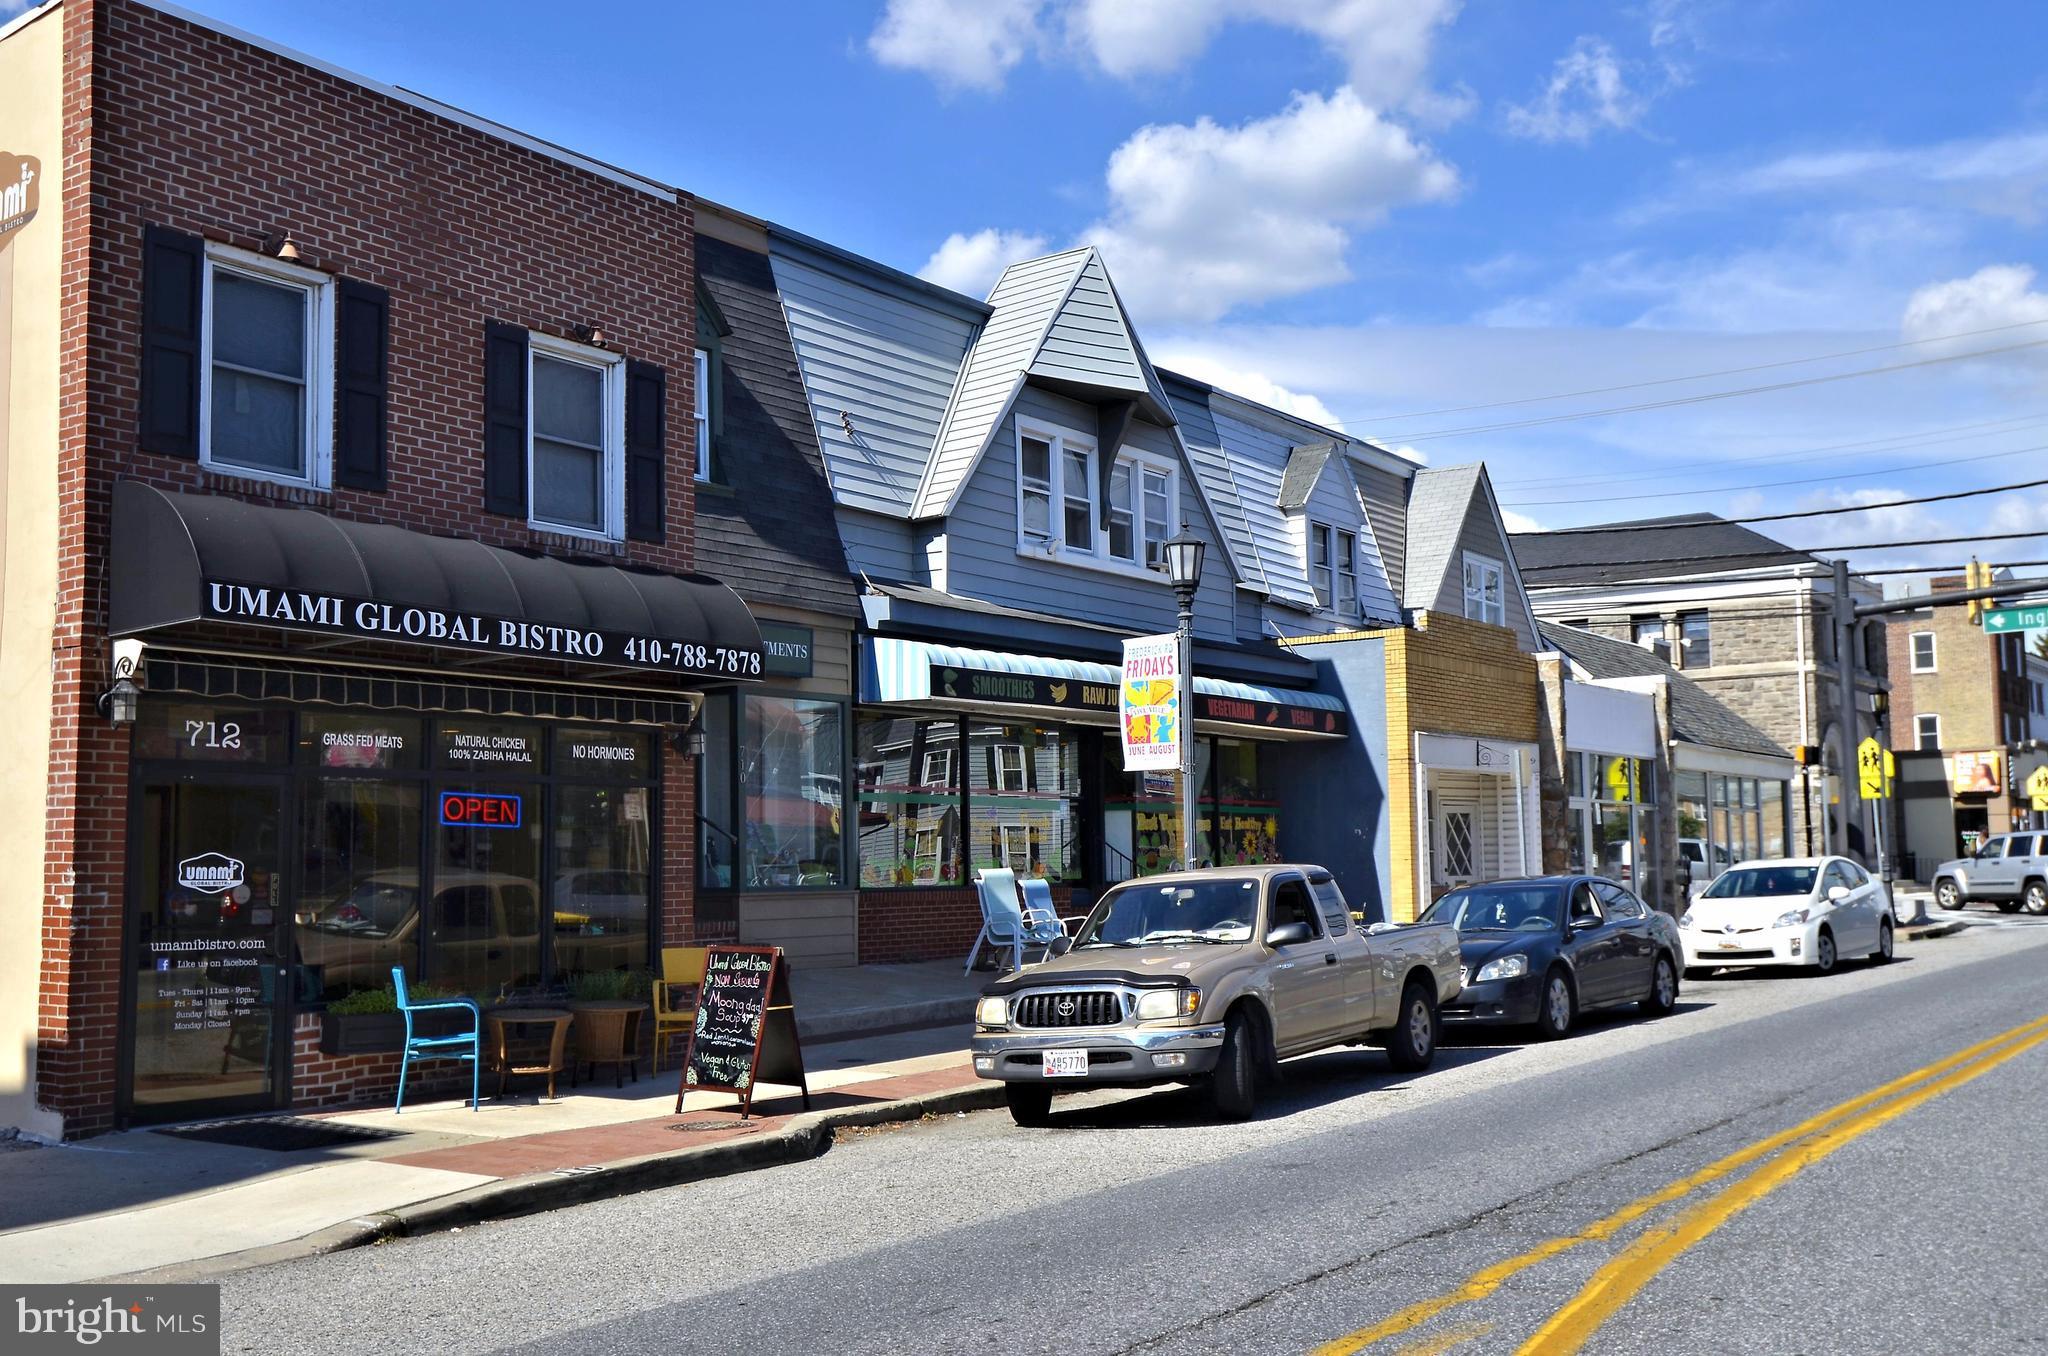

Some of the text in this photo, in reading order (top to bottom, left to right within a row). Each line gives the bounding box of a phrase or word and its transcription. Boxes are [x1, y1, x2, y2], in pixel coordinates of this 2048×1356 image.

[209, 582, 761, 675] UMAMI GLOBAL BISTRO 410-788-7878
[1126, 655, 1174, 679] FRIDAYS
[972, 675, 1035, 699] SMOOTHIES
[1082, 685, 1106, 704] RAW
[1207, 698, 1315, 726] VEGETARIAN VEGAN
[185, 720, 241, 749] 712
[323, 732, 403, 749] GRASS FED MEATS
[455, 734, 526, 750] NATURAL CHICKEN
[449, 749, 532, 763] 100% ZABIHA HALAL
[572, 744, 635, 761] NO HORMONES
[1128, 744, 1176, 756] JUNE AUGUST
[739, 745, 747, 784] 710
[444, 796, 517, 823] OPEN
[150, 939, 266, 952] umamibistro.com
[177, 960, 196, 969] Like
[223, 958, 258, 967] facebook
[158, 989, 177, 998] Tues
[182, 988, 204, 997] Thurs
[174, 1000, 186, 1008] Fri
[235, 997, 255, 1006] 10pm
[708, 989, 745, 1015] Moong
[176, 1010, 203, 1019] Sunday
[715, 1008, 741, 1029] Soup
[174, 1020, 231, 1031] Monday Closed
[701, 1051, 725, 1068] Vegan
[711, 1065, 729, 1082] Free
